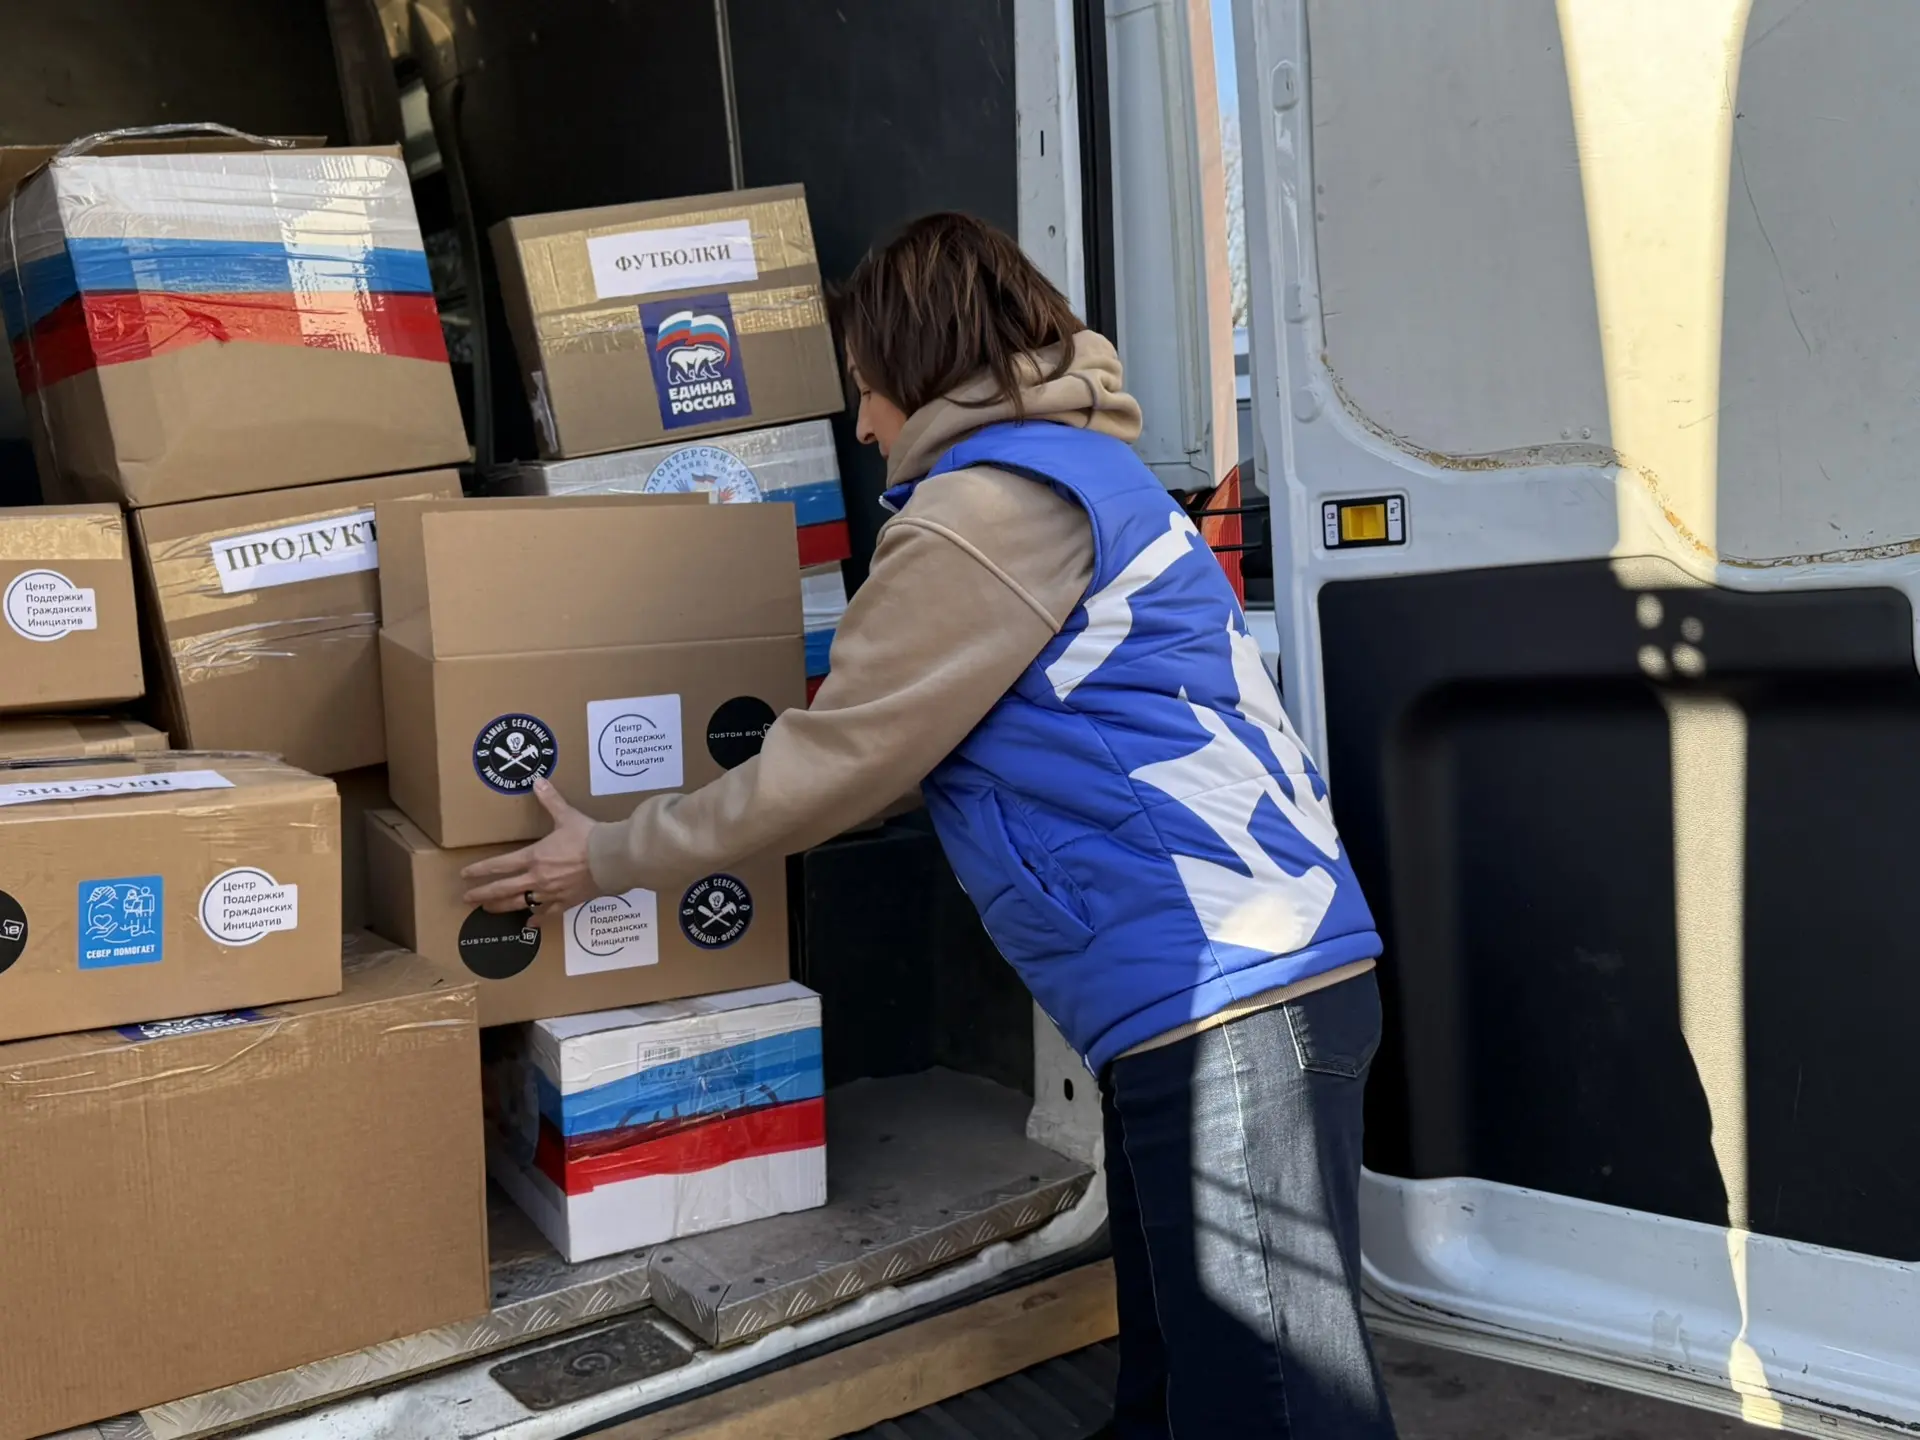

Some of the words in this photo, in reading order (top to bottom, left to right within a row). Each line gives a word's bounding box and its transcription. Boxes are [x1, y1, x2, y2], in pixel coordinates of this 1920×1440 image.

[615, 244, 732, 272] ФУТБОЛКИ
[668, 378, 733, 400] ЕДИНАЯ
[671, 392, 736, 415] РОССИЯ
[647, 448, 738, 493] ОЛОНТЕРСКИЙ
[223, 519, 377, 571] ПРОДУКТ
[25, 582, 56, 592] Центр
[26, 593, 83, 603] Поддержки
[27, 606, 92, 616] Гражданских
[28, 618, 83, 627] Инициатив
[482, 720, 508, 745] САМЫЕ
[511, 718, 549, 744] СЕВЕРНЫЕ
[614, 724, 642, 733] Центр
[709, 731, 743, 739] CUSTOM
[614, 733, 666, 744] Поддержки
[615, 744, 673, 757] Гражданских
[616, 756, 665, 767] Инициатив
[17, 779, 171, 797] ПЛАСТИК
[223, 881, 256, 892] Центр
[687, 880, 709, 904] САМЫЕ
[713, 878, 746, 900] СЕВЕРНЫЕ
[223, 891, 285, 905] Поддержки
[223, 903, 293, 919] Гражданских
[589, 903, 618, 913] Центр
[223, 918, 282, 931] Инициатив
[590, 912, 641, 925] Поддержки
[4, 925, 20, 935] 18
[590, 922, 648, 936] Гражданских
[460, 937, 499, 946] CUSTOM
[501, 934, 520, 942] BOX
[591, 935, 640, 947] Инициатив
[86, 948, 111, 960] СЕВЕР
[113, 944, 156, 956] ПОМОГАЕТ
